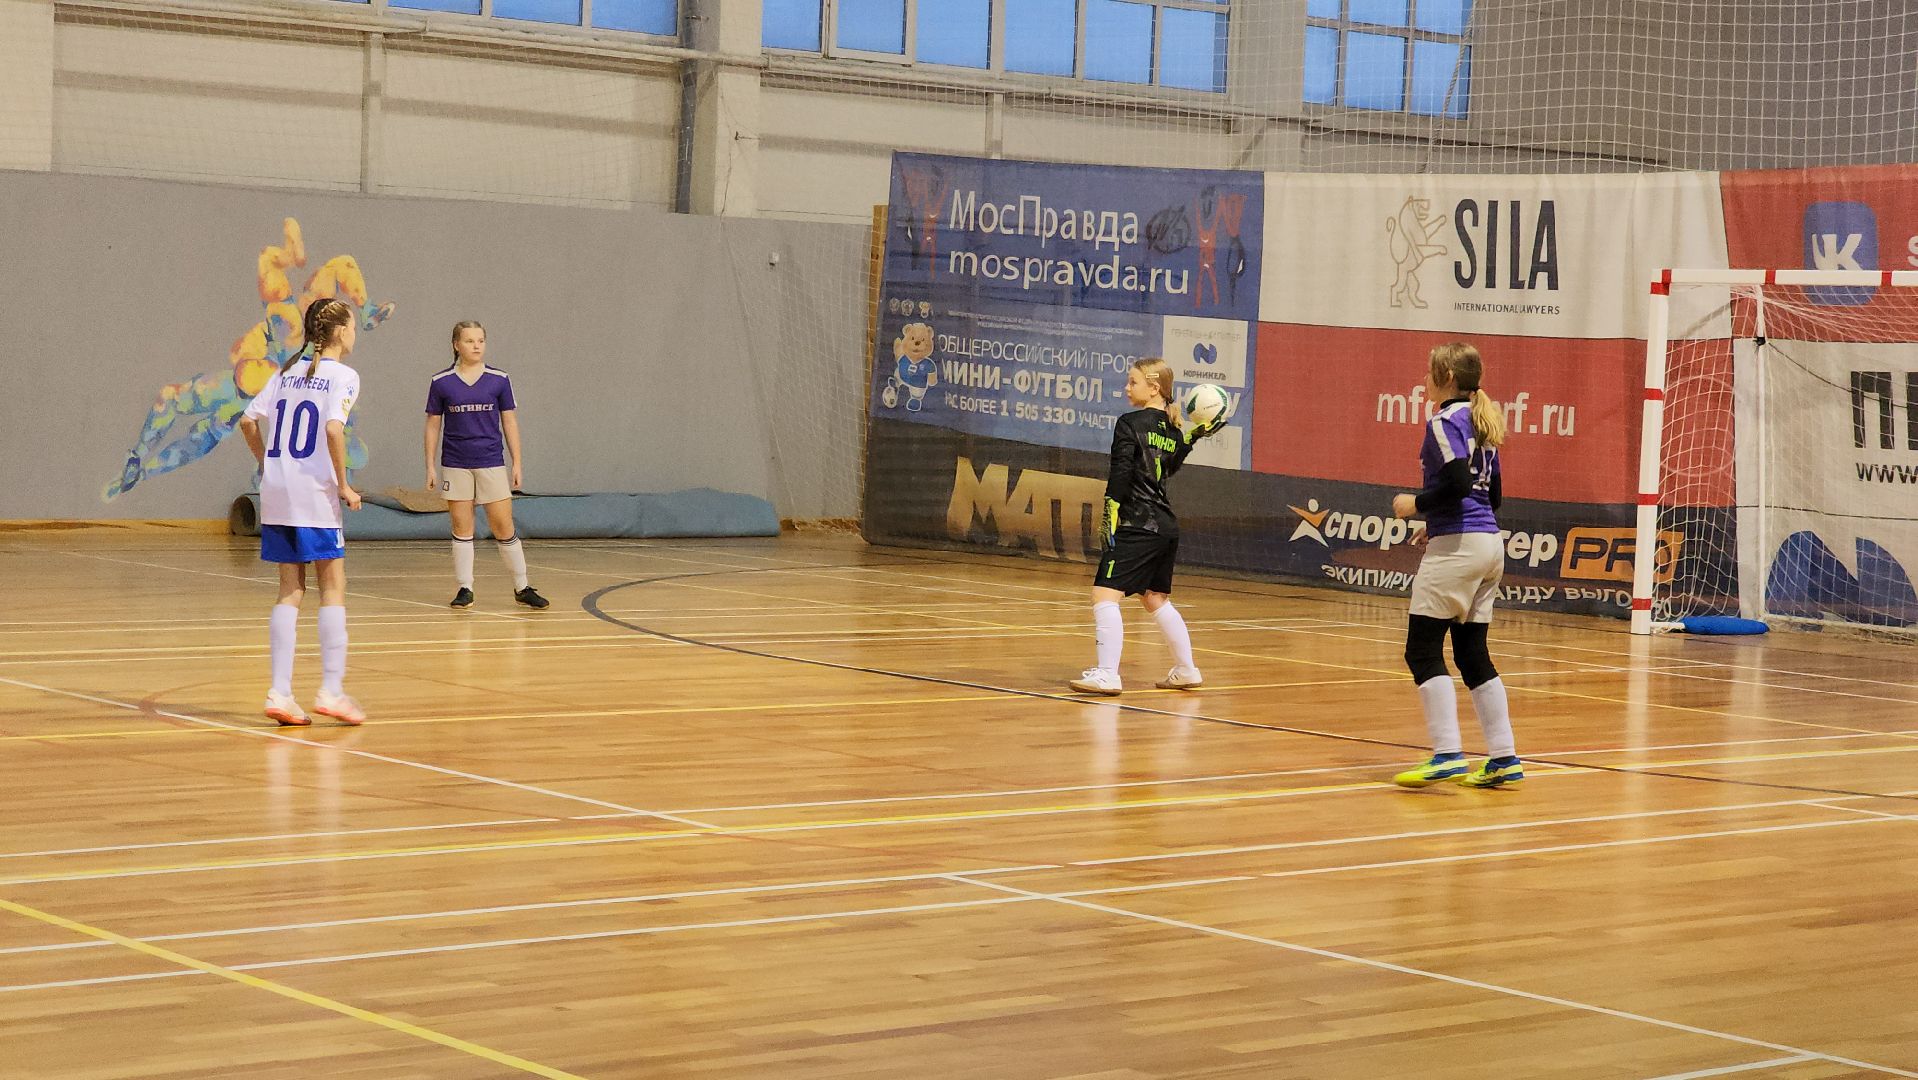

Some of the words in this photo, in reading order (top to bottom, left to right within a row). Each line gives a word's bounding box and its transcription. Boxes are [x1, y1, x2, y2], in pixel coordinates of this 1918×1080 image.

[949, 189, 1140, 250] МосПравда
[1454, 199, 1559, 290] SILA
[949, 249, 1189, 295] mospravda.ru
[1454, 302, 1518, 313] INTERNATIONAL
[938, 334, 1089, 370] ОБЩЕРОССИЙСКИЙ
[1091, 351, 1142, 374] ПРОЕ
[267, 399, 319, 459] 10
[960, 396, 997, 415] БОЛЕЕ
[1000, 399, 1009, 416] 1
[1015, 402, 1039, 421] 505
[1042, 405, 1075, 425] 330
[1106, 559, 1116, 579] 1
[1321, 564, 1413, 591] ЭКИПИРУ
